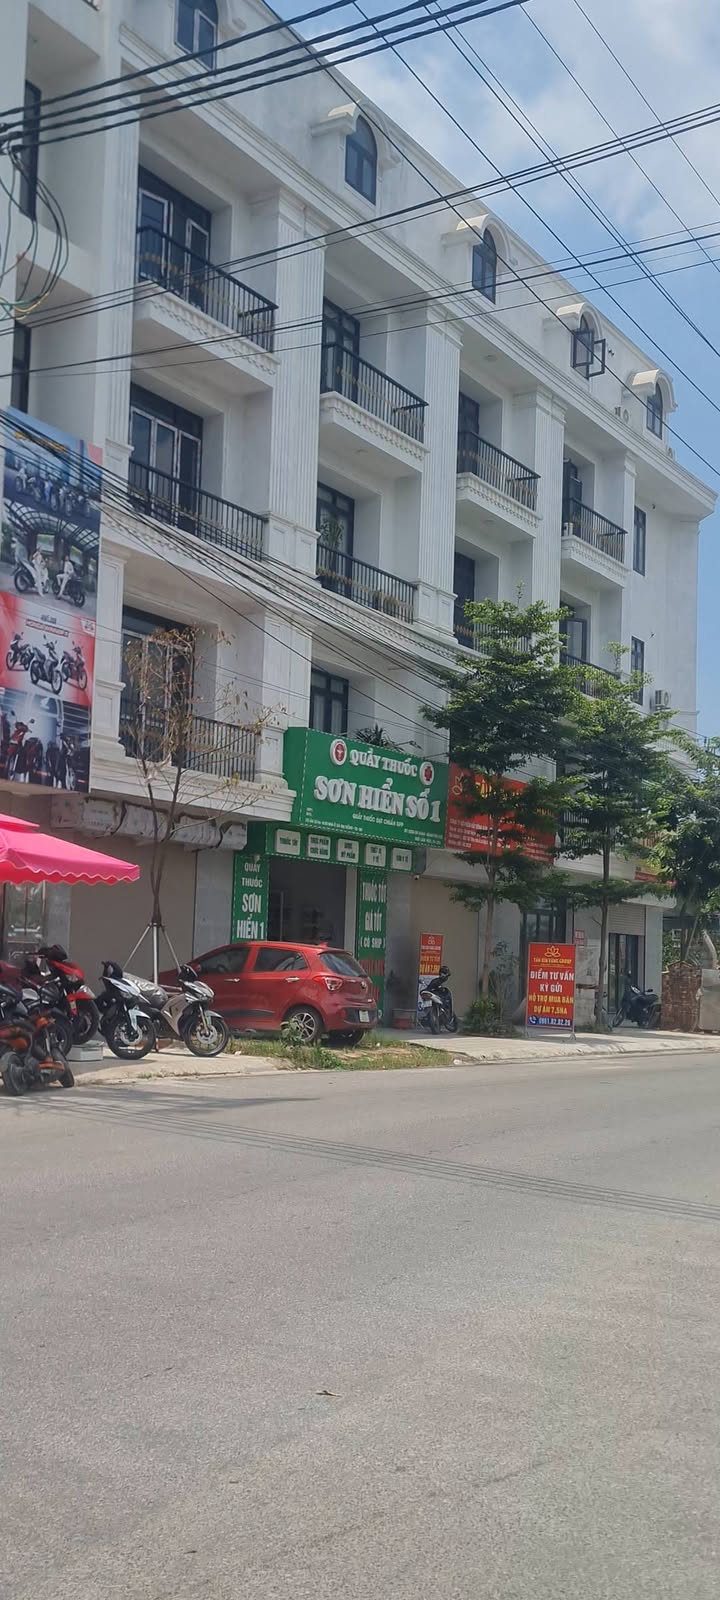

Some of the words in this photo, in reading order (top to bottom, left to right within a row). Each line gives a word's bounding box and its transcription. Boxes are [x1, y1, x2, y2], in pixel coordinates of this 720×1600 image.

[381, 757, 418, 777] THUỐC
[314, 775, 357, 806] SƠN
[358, 777, 405, 816] HIỂN
[405, 787, 431, 820] SỐ
[430, 800, 441, 822] 1
[241, 875, 263, 888] THUỐC
[241, 892, 262, 913] SƠN
[236, 913, 258, 940] HIỂN
[259, 921, 265, 940] 1
[530, 968, 549, 979] ĐIỂM
[549, 971, 559, 980] TƯ
[559, 970, 574, 980] VẤN
